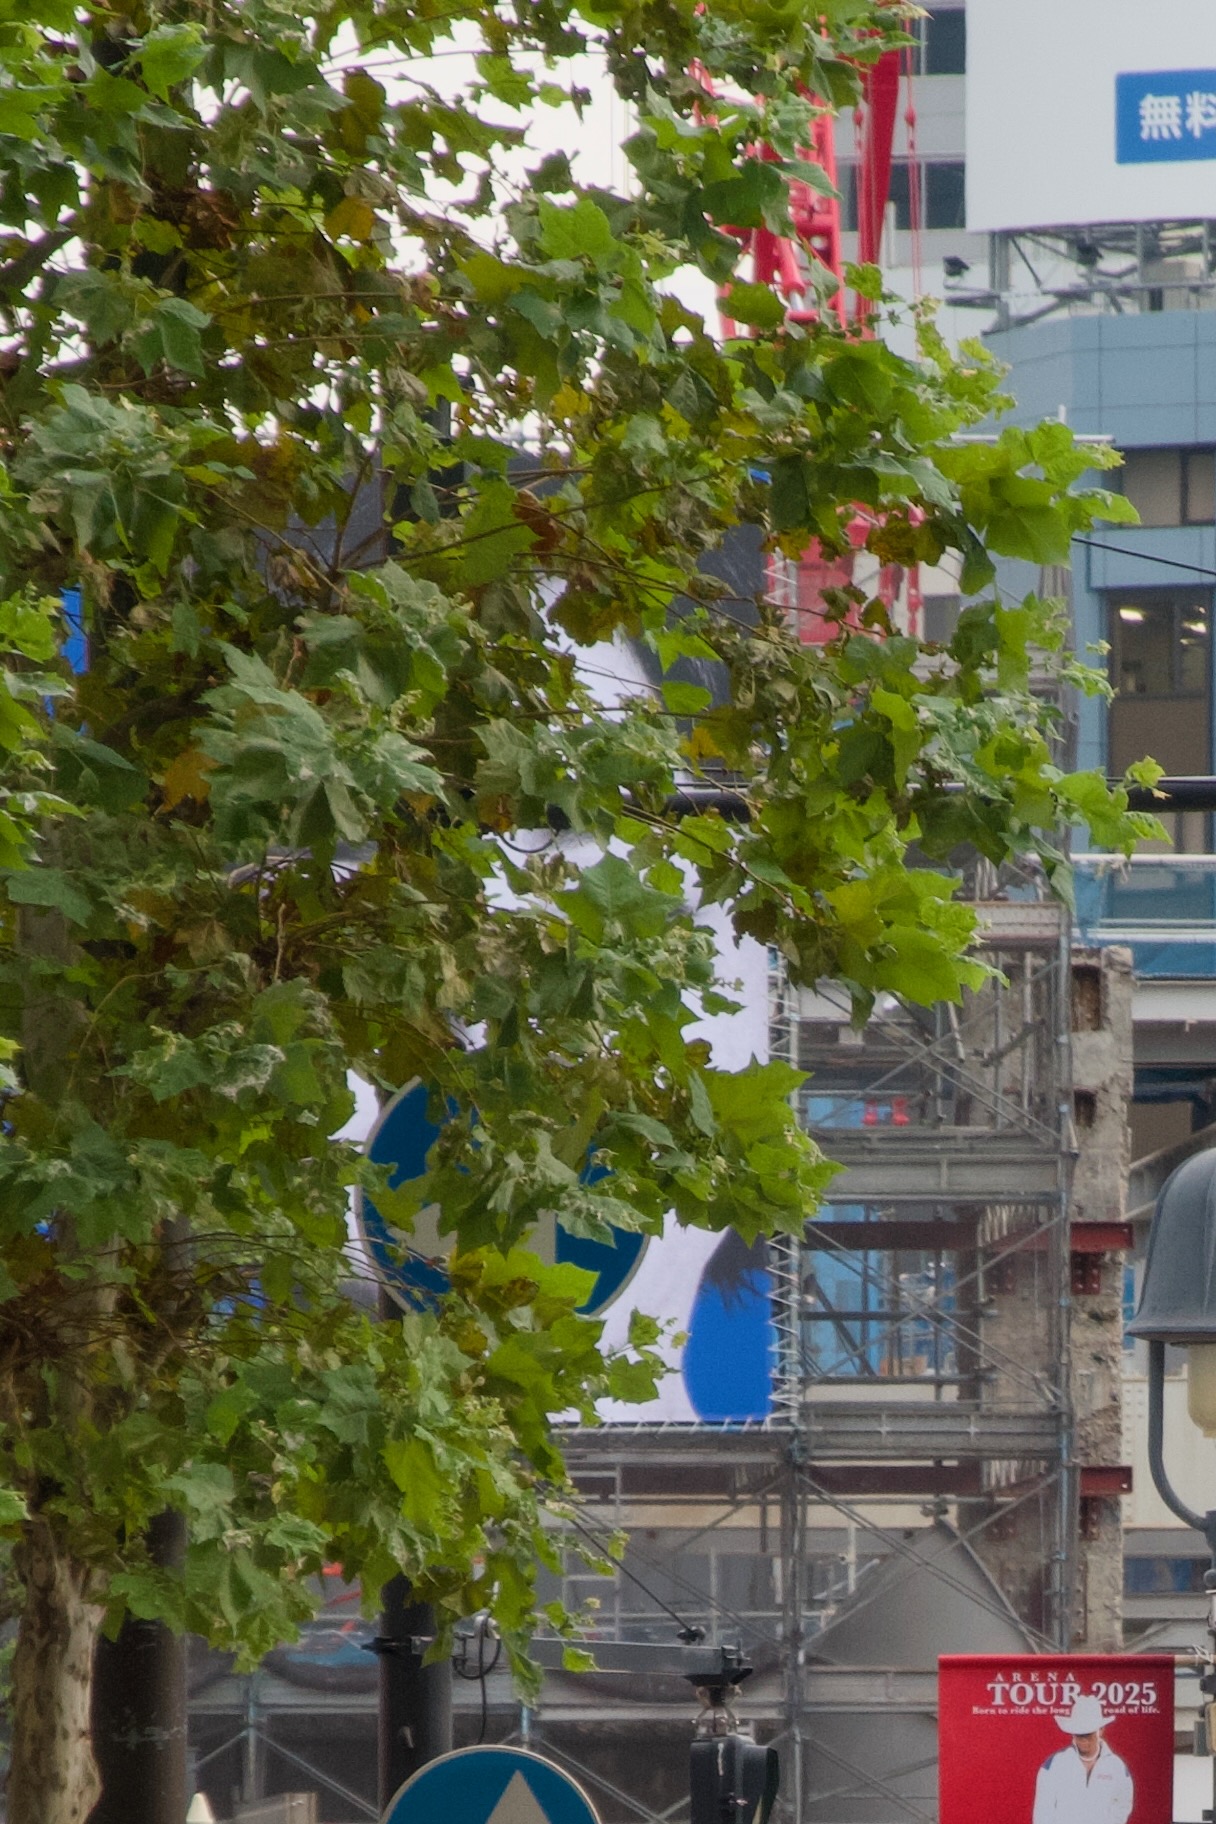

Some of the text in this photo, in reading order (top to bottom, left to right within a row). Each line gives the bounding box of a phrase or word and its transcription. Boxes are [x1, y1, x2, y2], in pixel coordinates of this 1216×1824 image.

[993, 1672, 1077, 1682] ARENA
[986, 1681, 1157, 1707] TOUR 2025
[972, 1705, 996, 1715] Born
[997, 1706, 1009, 1715] to
[1010, 1705, 1031, 1715] ride
[1032, 1705, 1048, 1715] the
[1049, 1705, 1071, 1716] long
[1103, 1705, 1126, 1715] road
[1127, 1705, 1139, 1715] of
